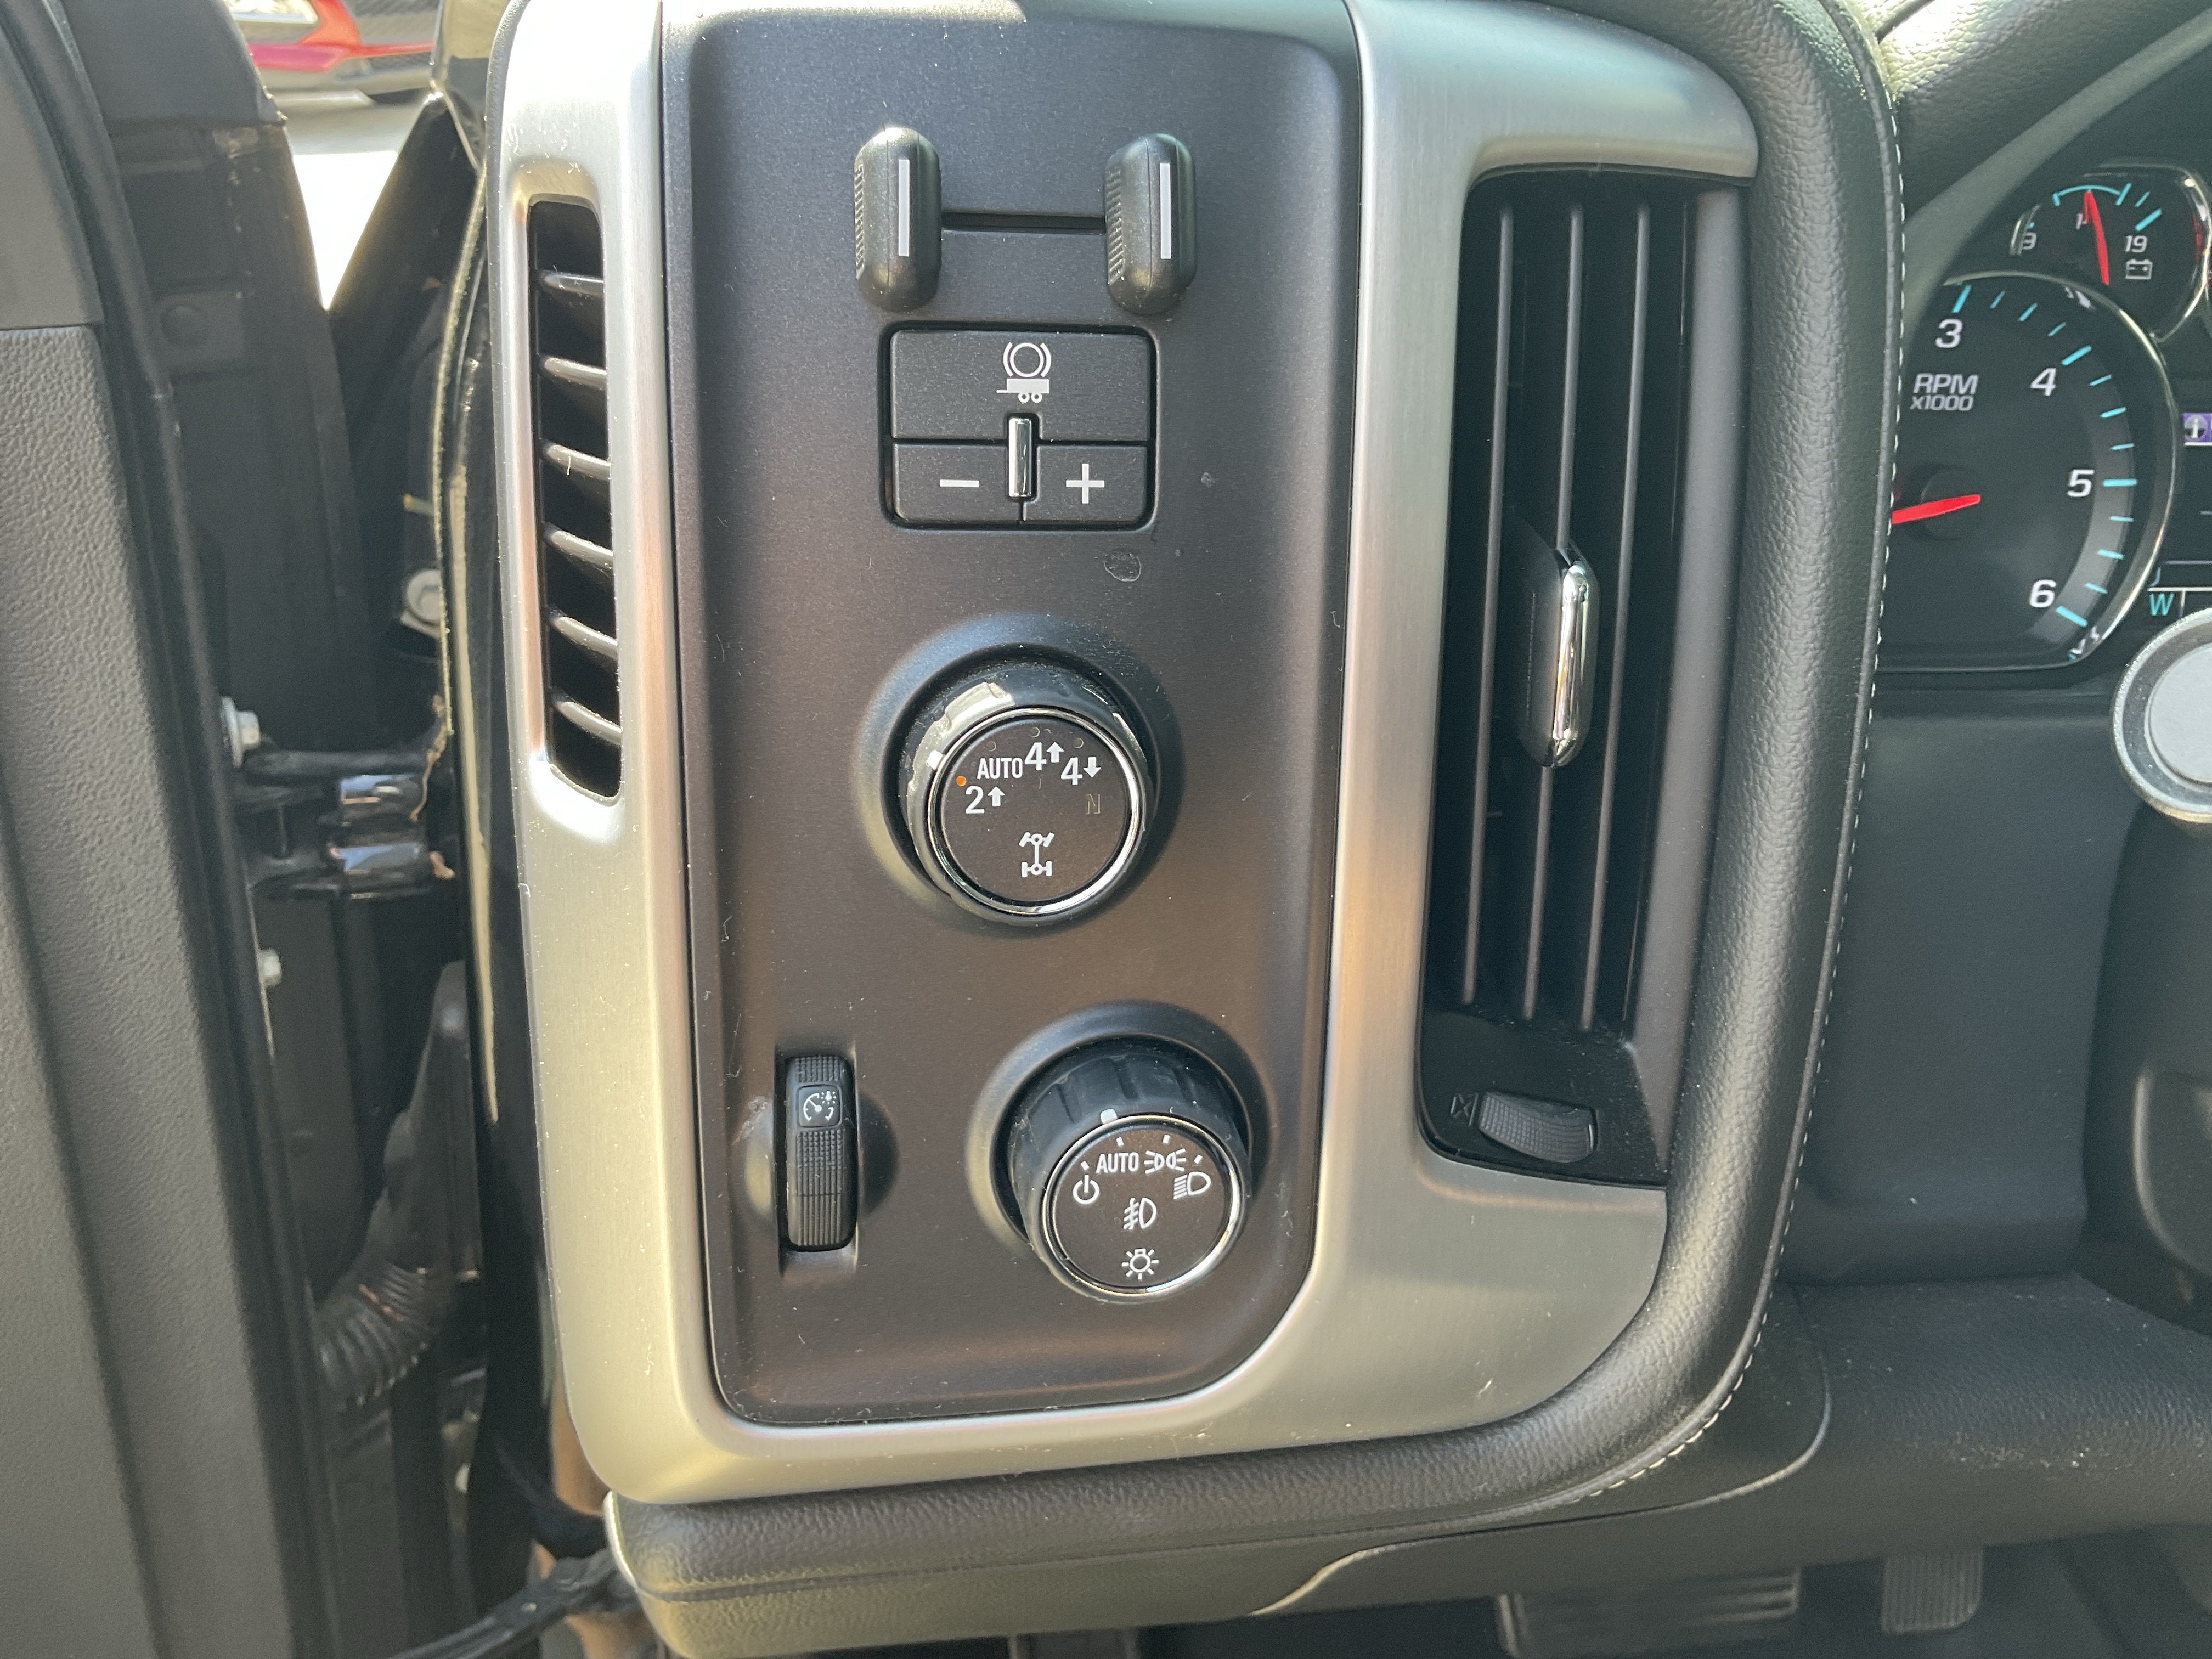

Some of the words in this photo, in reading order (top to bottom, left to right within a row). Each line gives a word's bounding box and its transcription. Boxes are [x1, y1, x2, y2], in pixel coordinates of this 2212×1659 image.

[2125, 235, 2148, 253] 19
[1935, 318, 1963, 348] 3
[1913, 373, 1979, 395] RPM
[2030, 367, 2057, 397] 4
[2067, 469, 2095, 498] 5
[2029, 579, 2057, 608] 6
[2149, 592, 2174, 616] W
[976, 757, 1023, 780] AUTO
[1024, 742, 1047, 771] 4
[1060, 757, 1084, 786] 4
[964, 785, 985, 814] 2
[1096, 1152, 1140, 1174] AUTO
